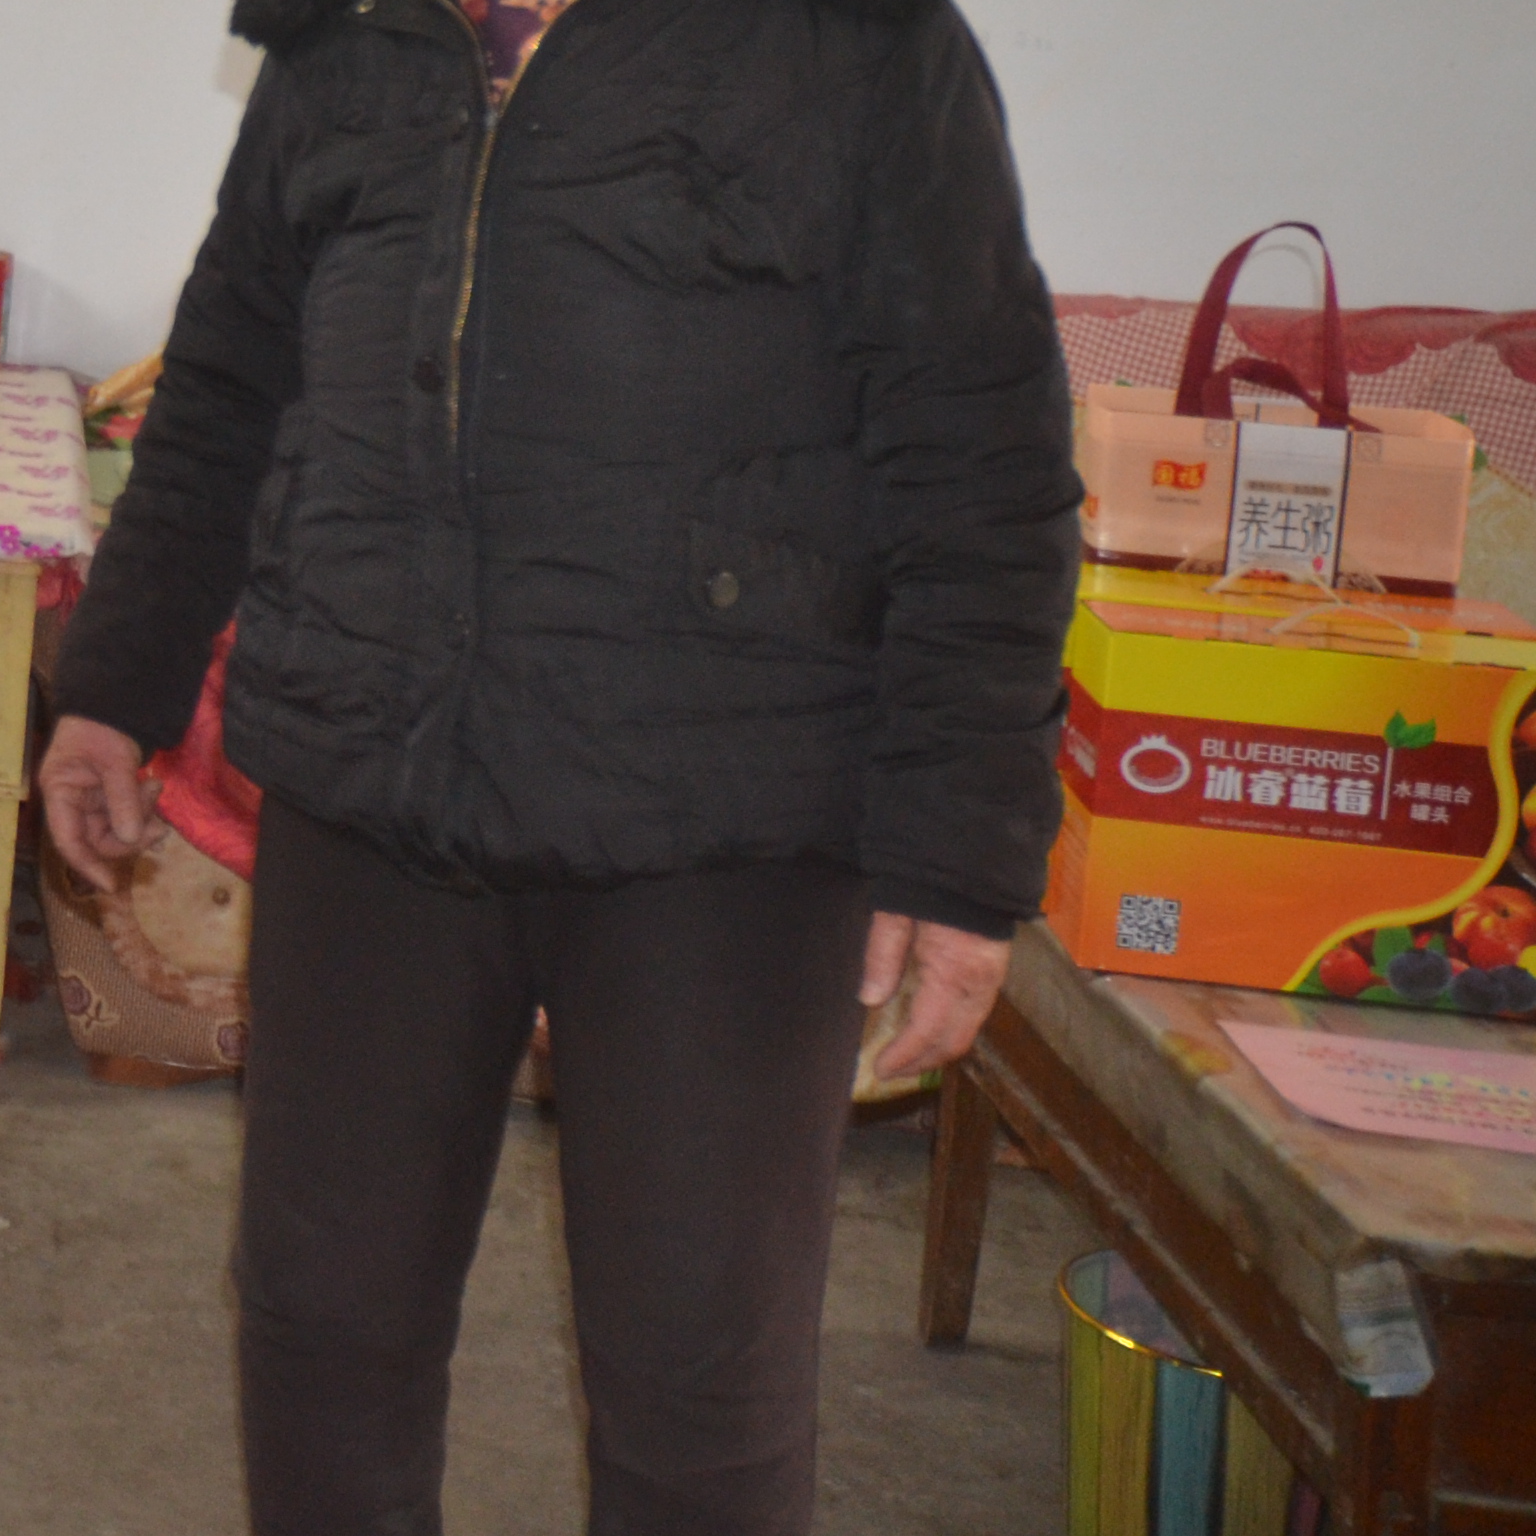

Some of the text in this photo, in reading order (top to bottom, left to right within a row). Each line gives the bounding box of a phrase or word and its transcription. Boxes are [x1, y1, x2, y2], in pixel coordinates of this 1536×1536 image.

[1238, 497, 1335, 555] 养生粥
[1200, 738, 1381, 775] BLUEBERRIES
[1203, 765, 1374, 815] 冰睿蓝莓
[1392, 780, 1472, 805] 水果组合
